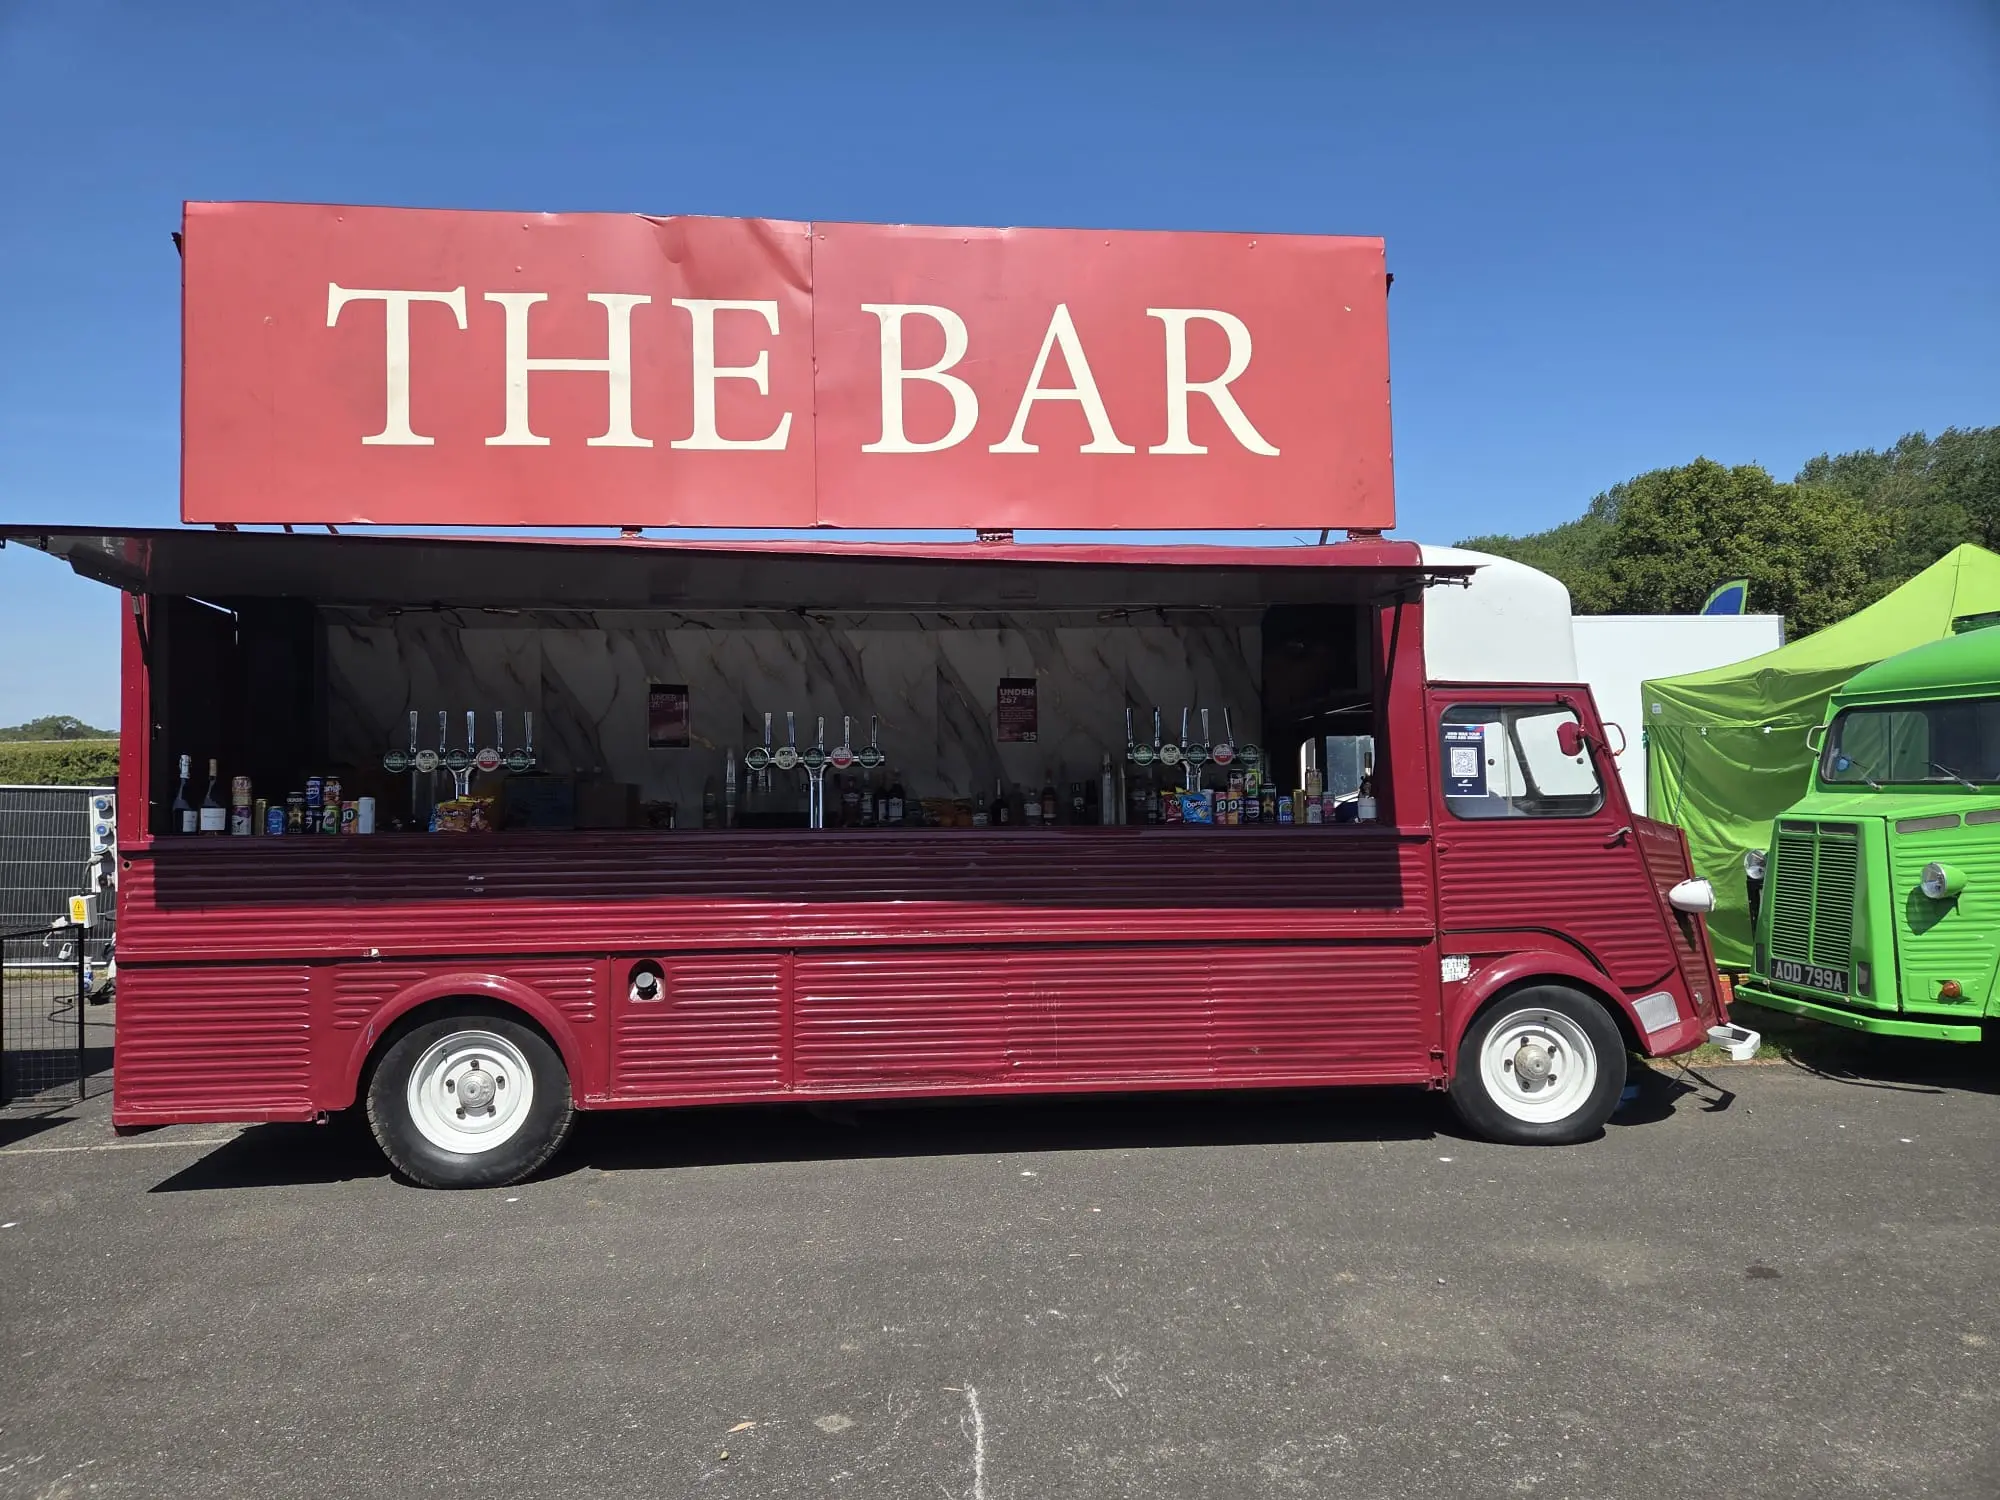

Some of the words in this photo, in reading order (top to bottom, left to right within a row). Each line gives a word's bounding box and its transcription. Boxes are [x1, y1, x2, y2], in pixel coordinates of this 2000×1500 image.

[326, 282, 793, 450] THE
[861, 303, 1281, 456] BAR
[1000, 688, 1035, 696] UNDER
[1775, 961, 1801, 982] AOD
[1805, 966, 1843, 991] 799A
